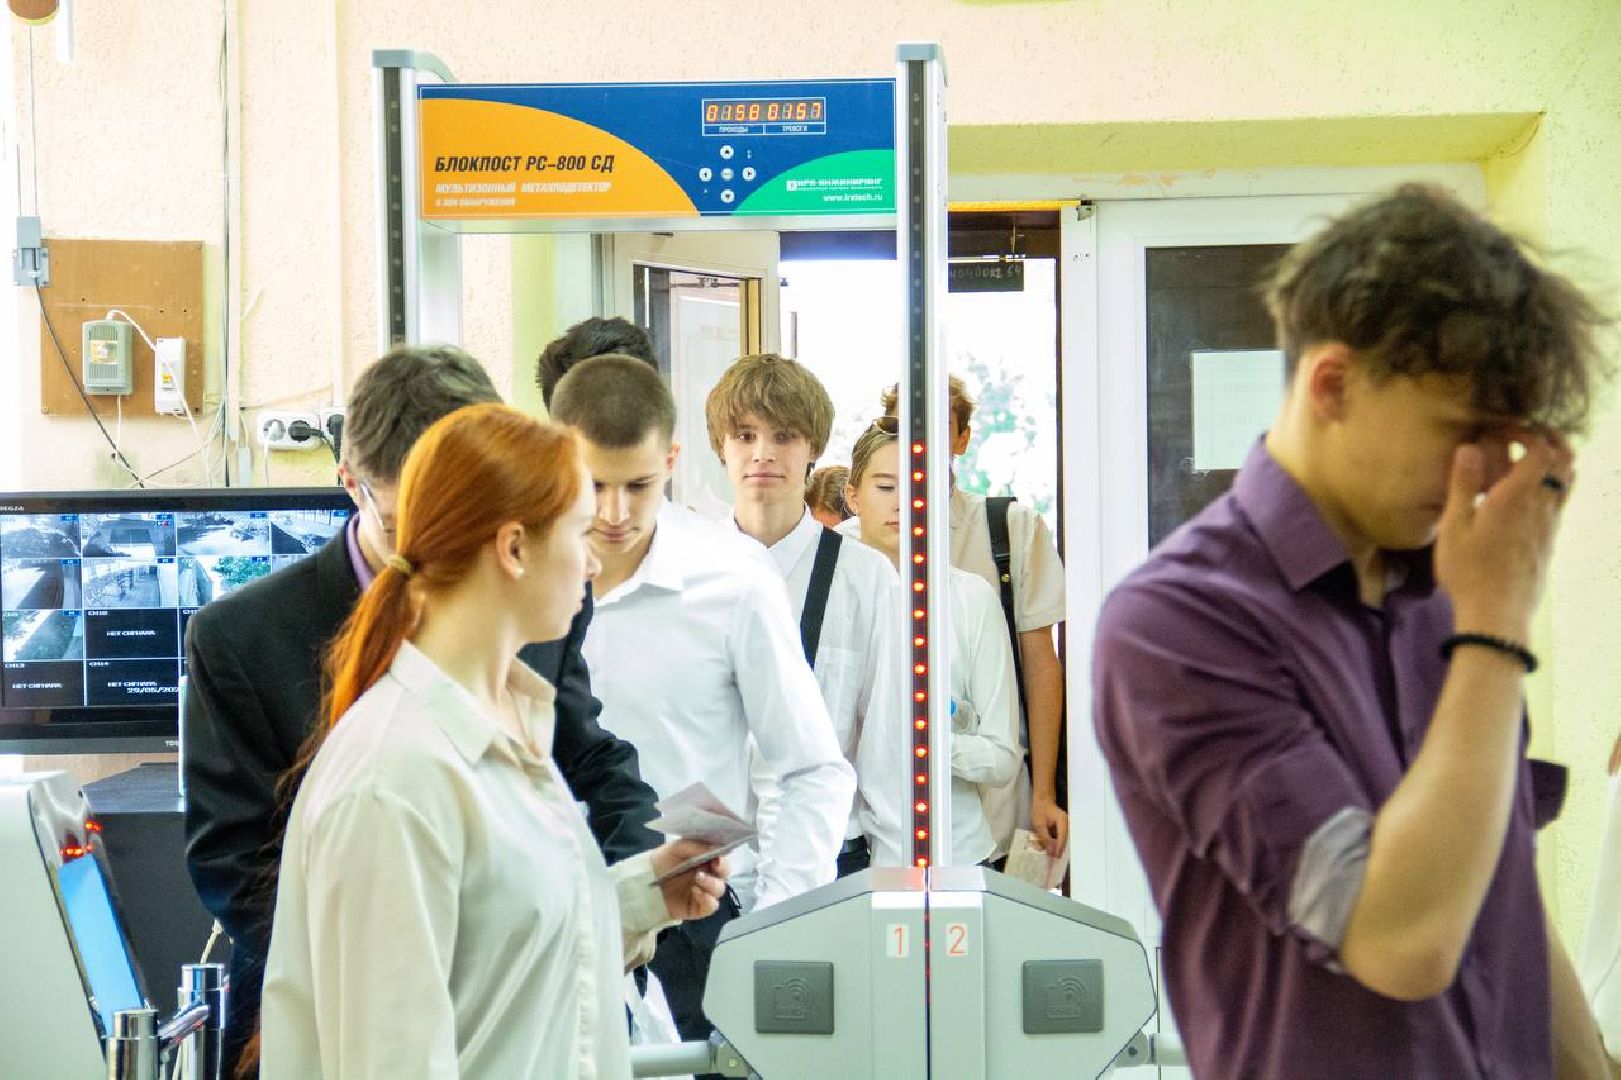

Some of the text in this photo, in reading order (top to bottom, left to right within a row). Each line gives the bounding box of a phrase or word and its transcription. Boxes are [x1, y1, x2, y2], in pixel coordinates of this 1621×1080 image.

[435, 155, 521, 173] БЛОКПОСТ
[591, 154, 615, 173] СД
[435, 181, 517, 193] МУЛЬТИЗОННЫЙ
[894, 927, 903, 956] 1
[949, 925, 967, 954] 2
